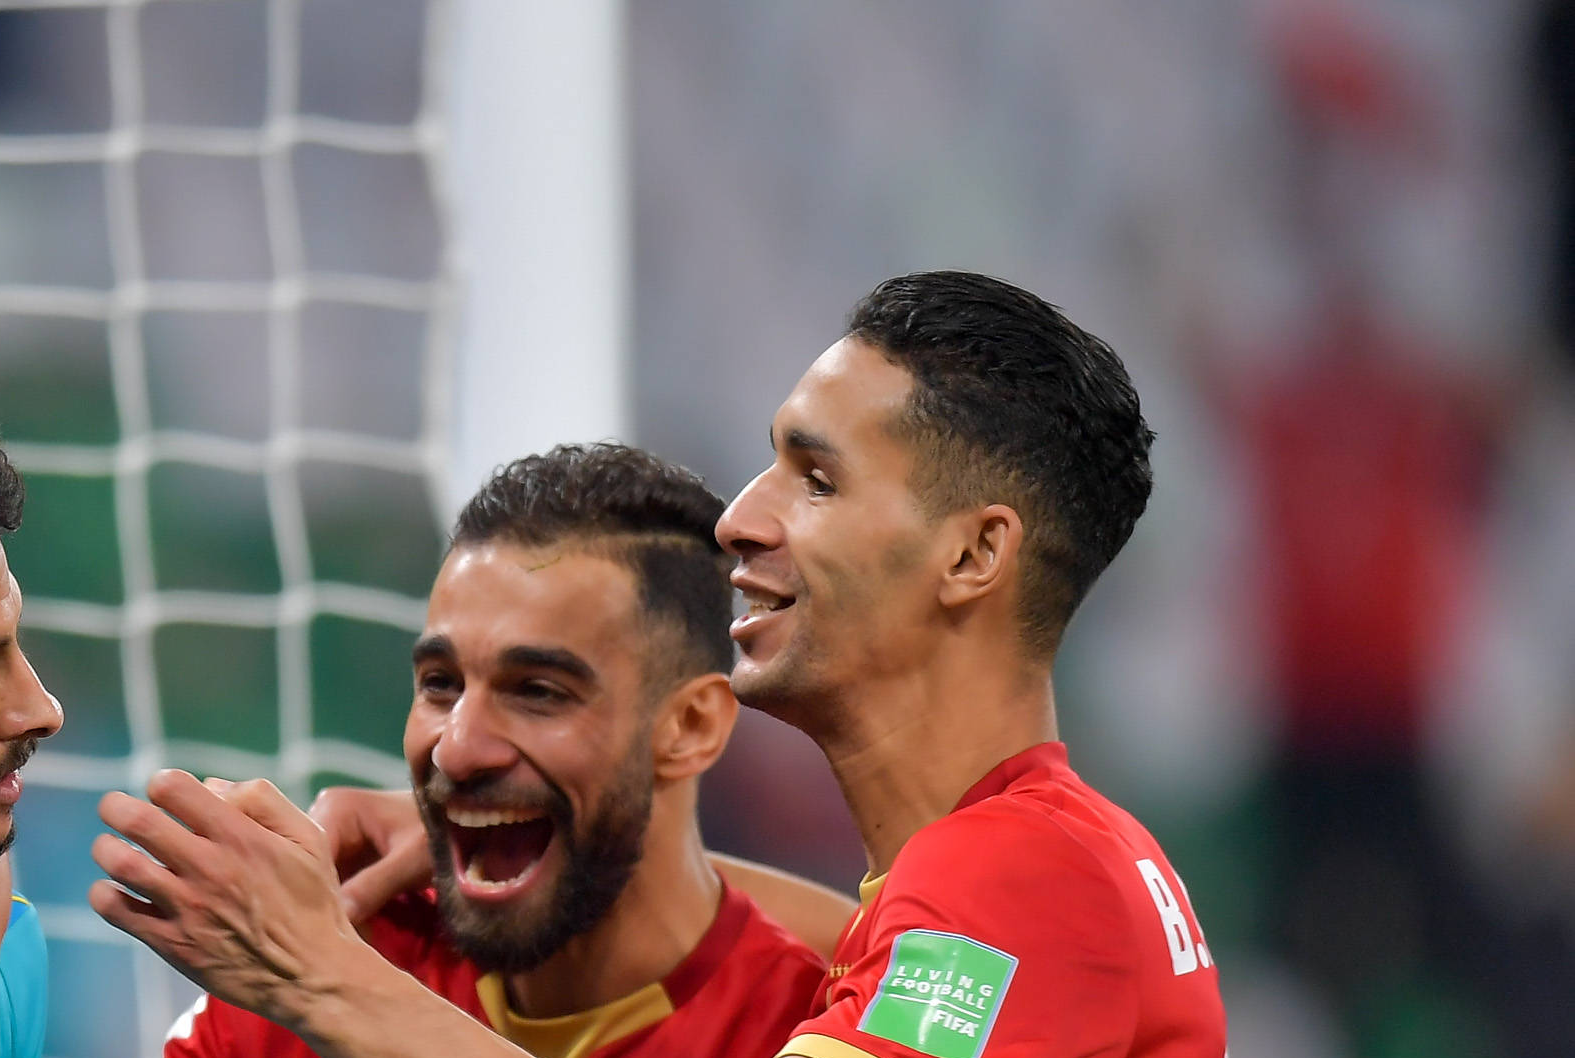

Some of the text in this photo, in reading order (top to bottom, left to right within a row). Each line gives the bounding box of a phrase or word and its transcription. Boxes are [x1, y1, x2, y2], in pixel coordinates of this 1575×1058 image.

[890, 977, 986, 1010] FOOTBALL
[896, 965, 994, 997] LIVING
[931, 1009, 980, 1038] FIFA
